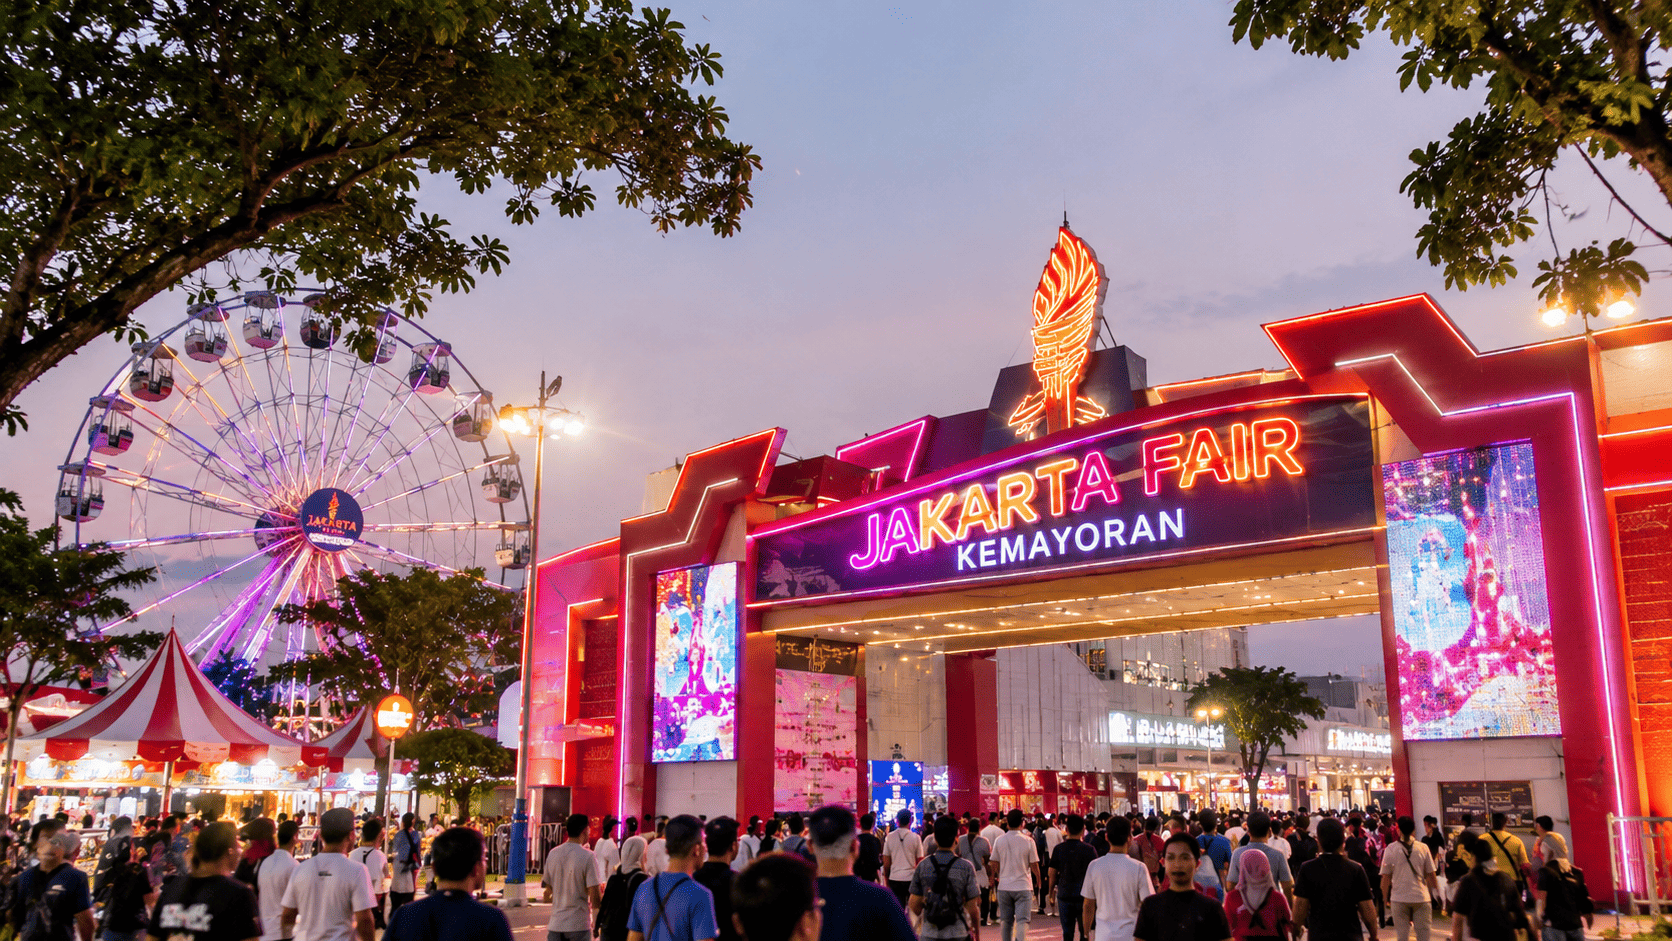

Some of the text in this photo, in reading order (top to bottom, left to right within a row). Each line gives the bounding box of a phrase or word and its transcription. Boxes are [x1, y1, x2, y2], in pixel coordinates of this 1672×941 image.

[849, 417, 1303, 570] JAKARTA FAIR
[957, 507, 1185, 571] KEMAYORAN
